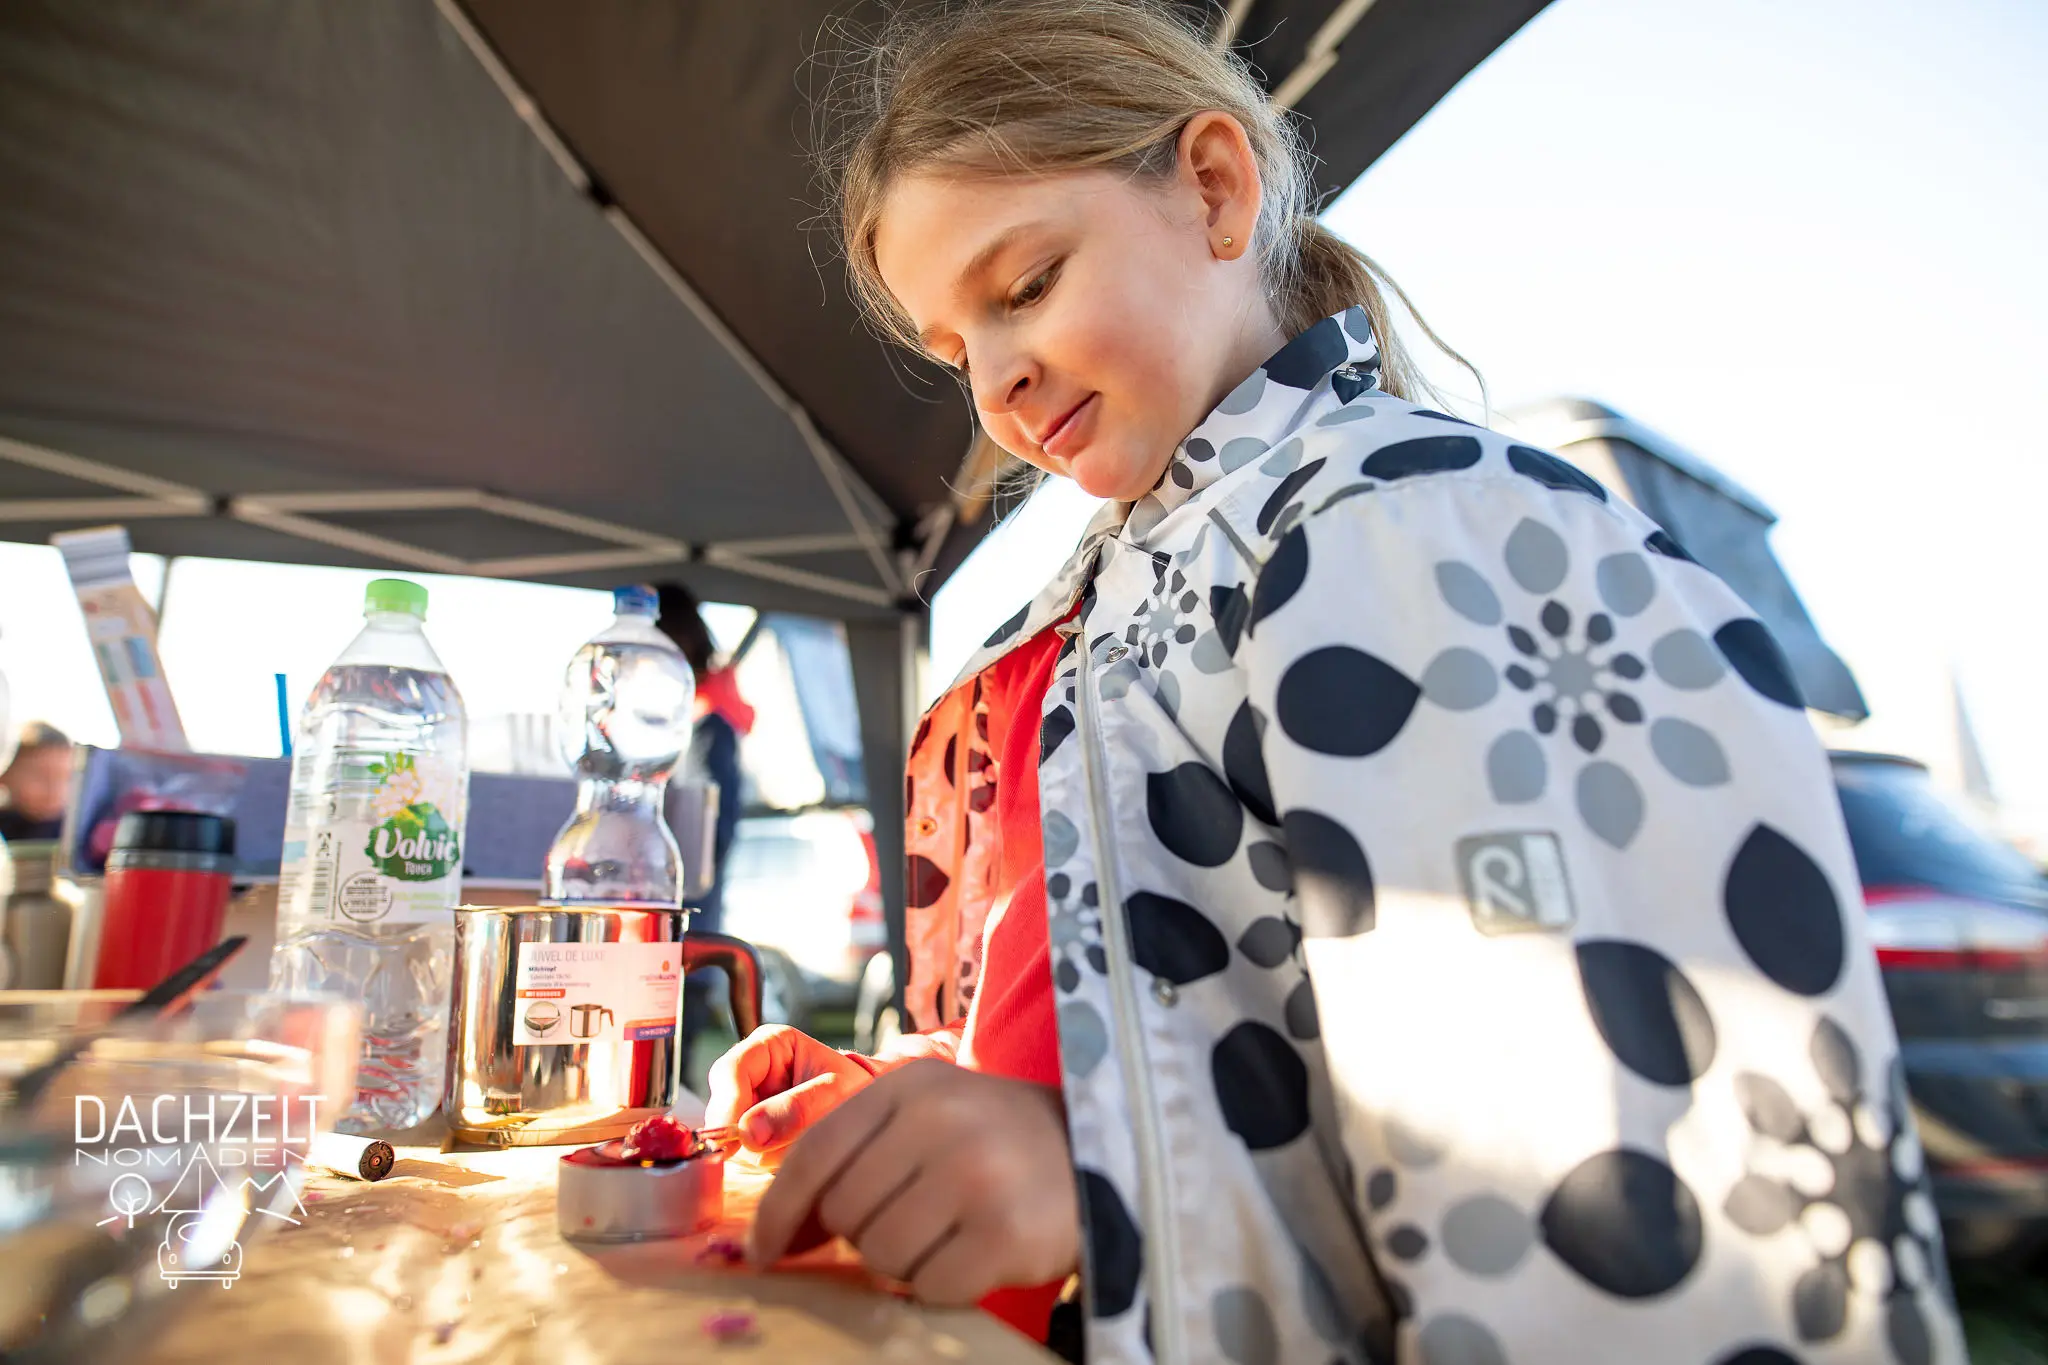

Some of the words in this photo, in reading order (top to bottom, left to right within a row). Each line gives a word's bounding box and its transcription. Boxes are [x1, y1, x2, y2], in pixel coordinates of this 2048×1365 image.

[374, 828, 457, 861] Volvic
[565, 950, 578, 961] DE
[581, 950, 606, 961] LUXE
